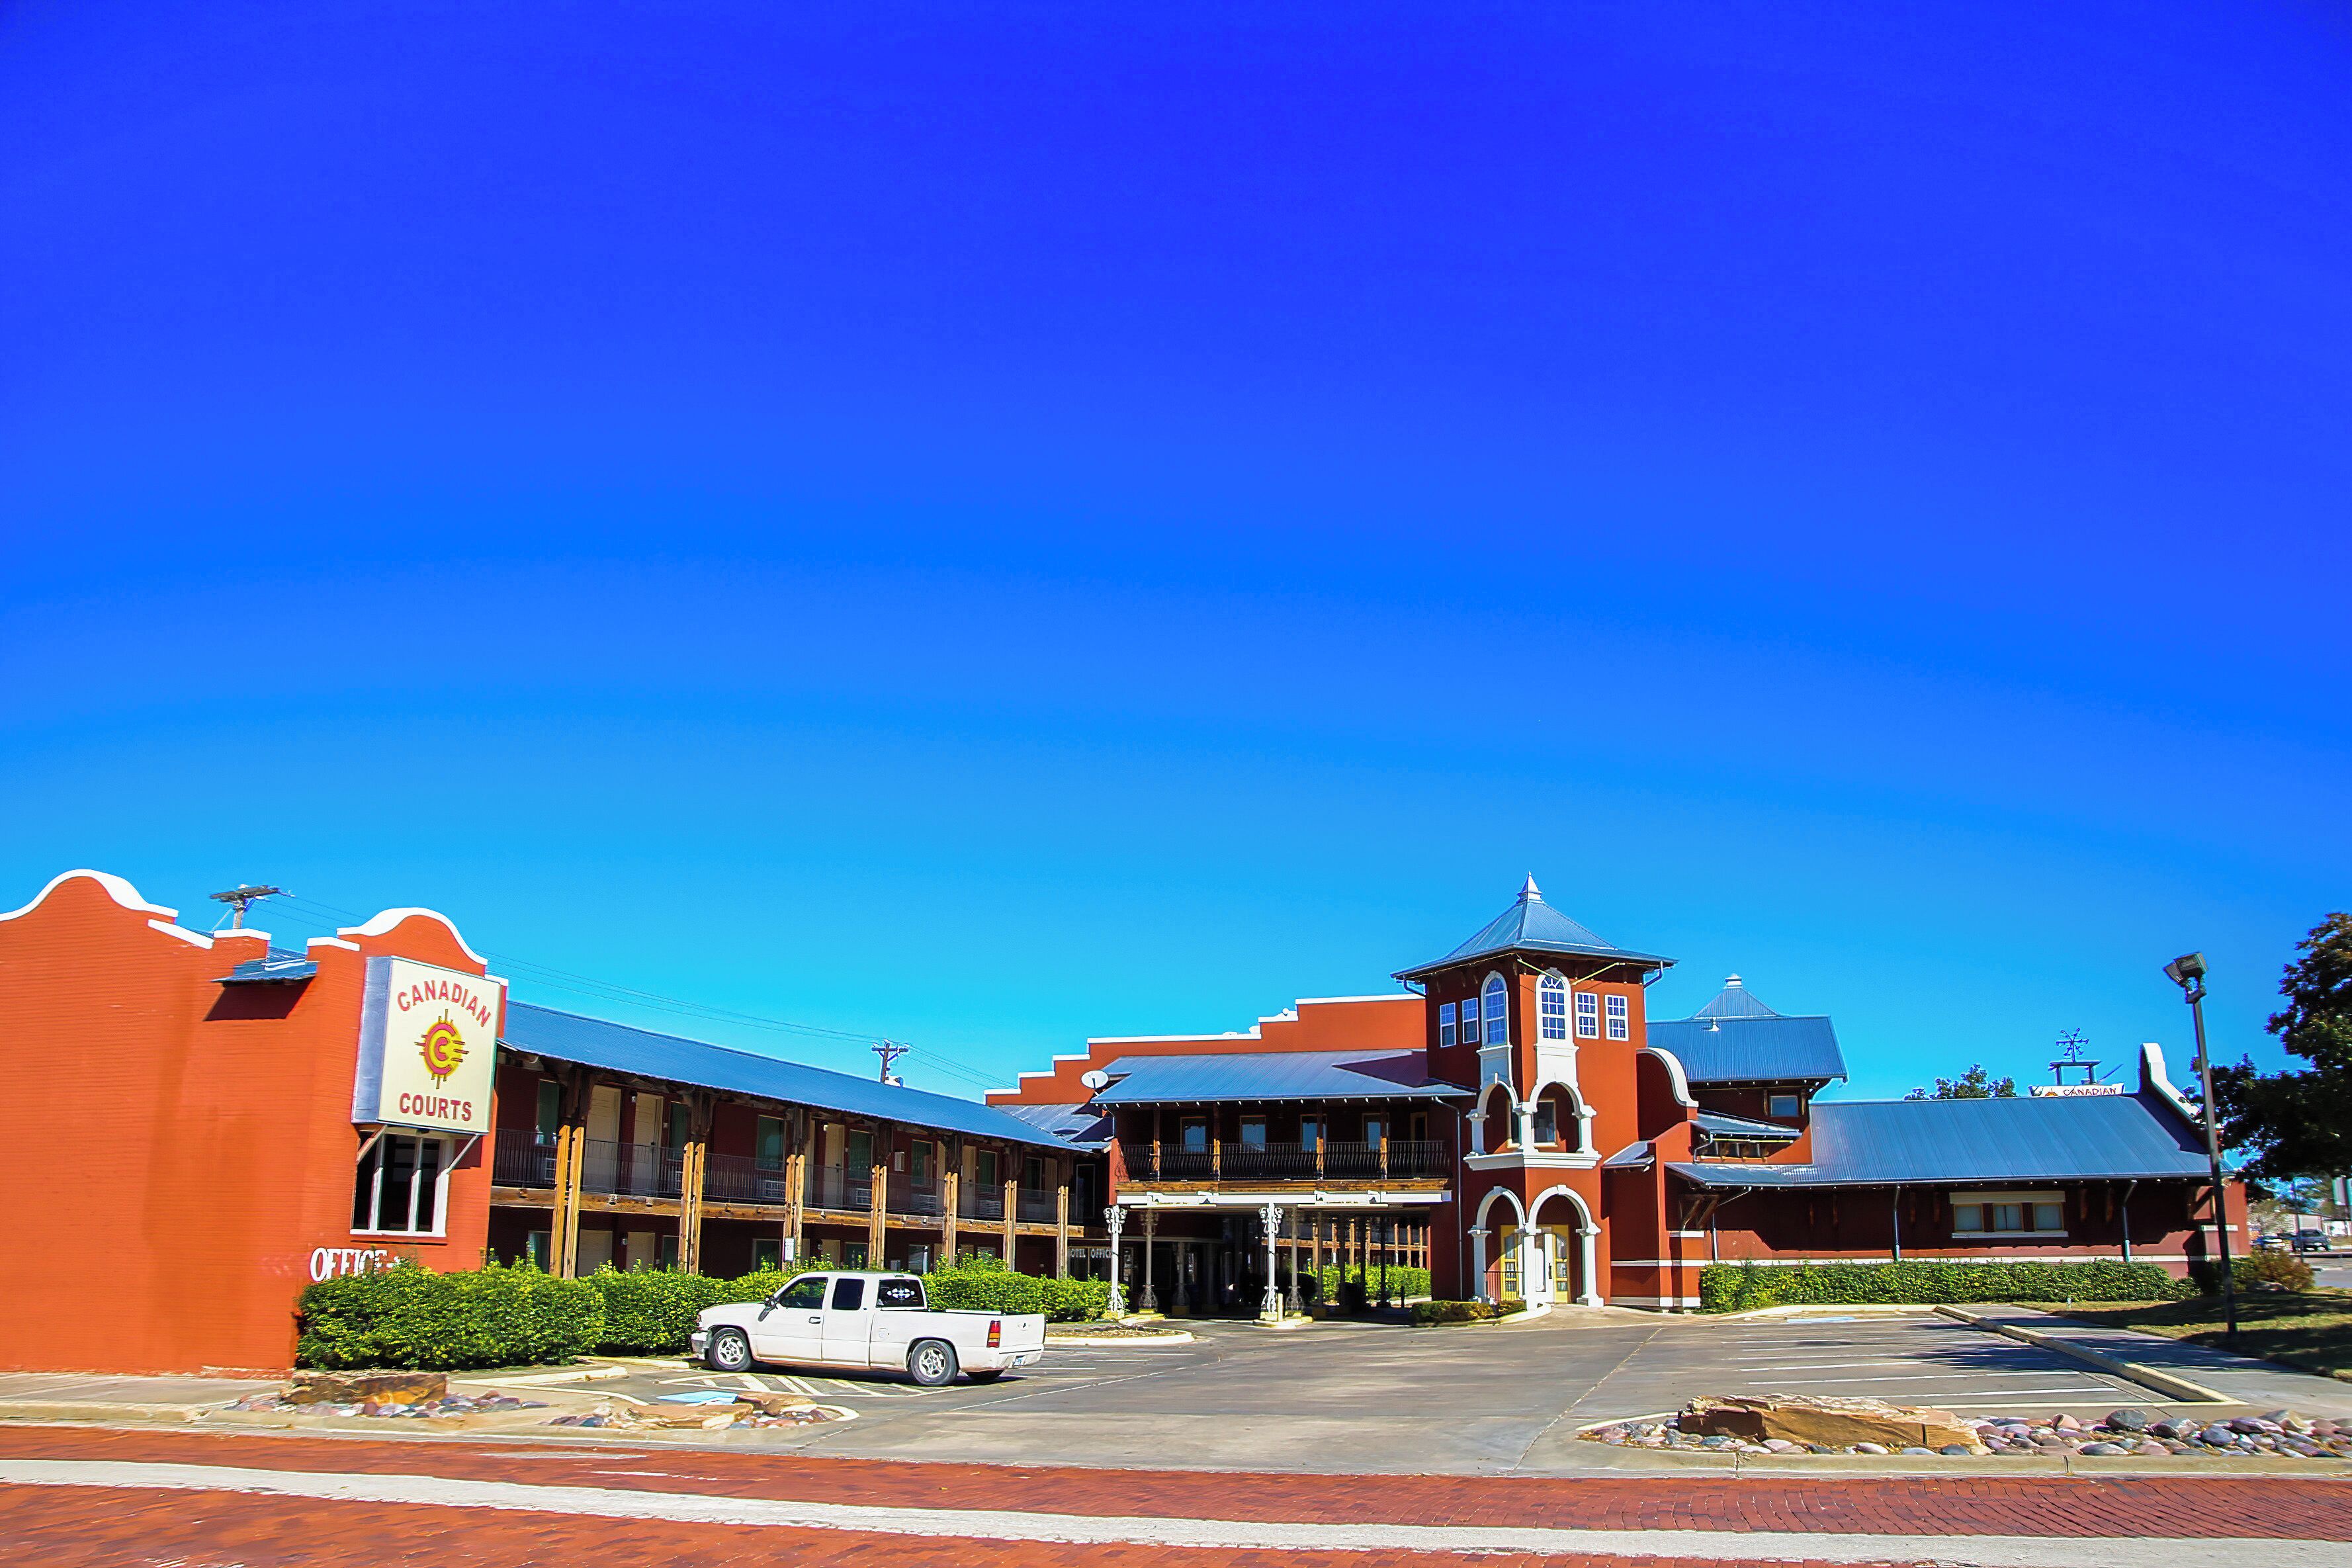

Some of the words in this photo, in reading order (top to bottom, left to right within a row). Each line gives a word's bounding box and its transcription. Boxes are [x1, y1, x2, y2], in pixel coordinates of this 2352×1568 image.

[397, 980, 492, 1027] CANADIAN
[399, 1092, 472, 1121] COURTS
[2063, 1088, 2116, 1096] CANADIAN
